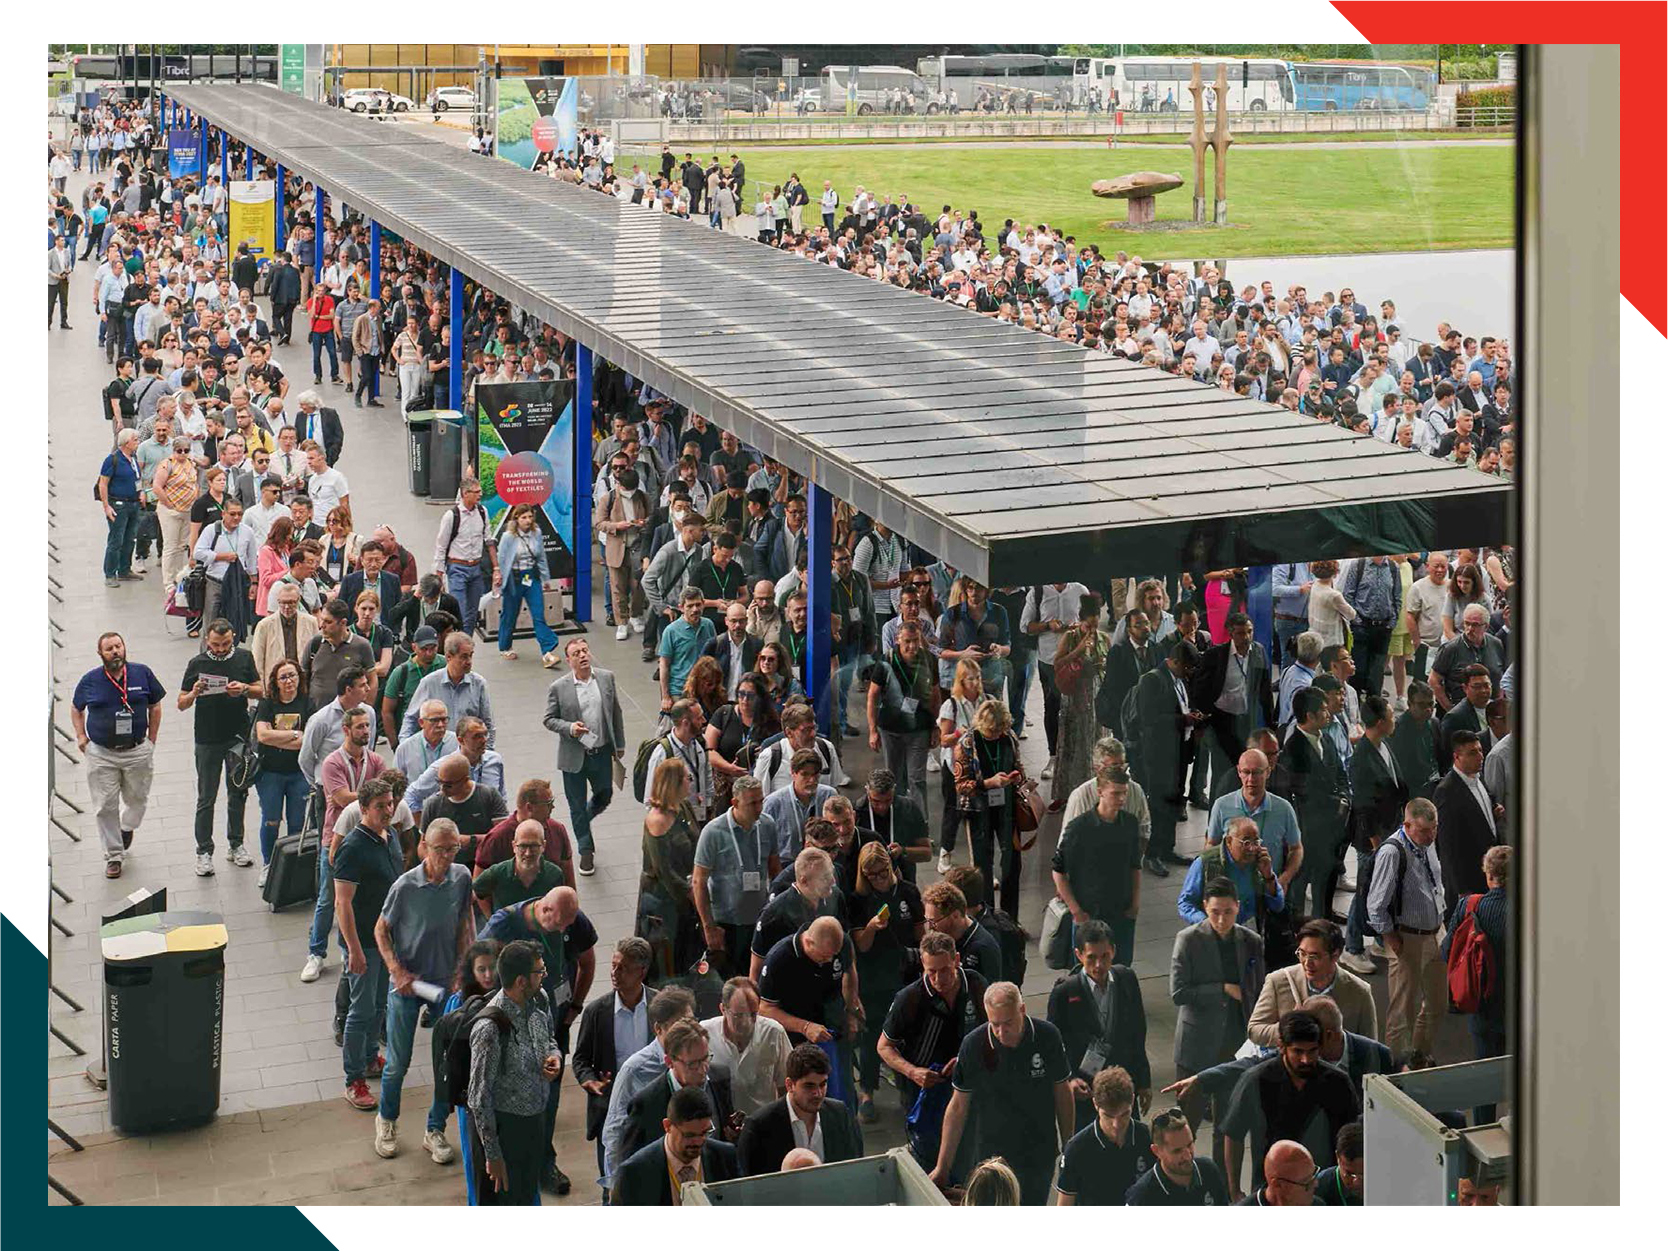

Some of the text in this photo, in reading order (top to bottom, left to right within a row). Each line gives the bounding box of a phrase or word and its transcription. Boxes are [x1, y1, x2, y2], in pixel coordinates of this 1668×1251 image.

[502, 471, 549, 479] TRANSFORMING
[110, 994, 120, 1059] CARTA PAPER
[213, 978, 223, 1069] PLASTICA PLASTIC
